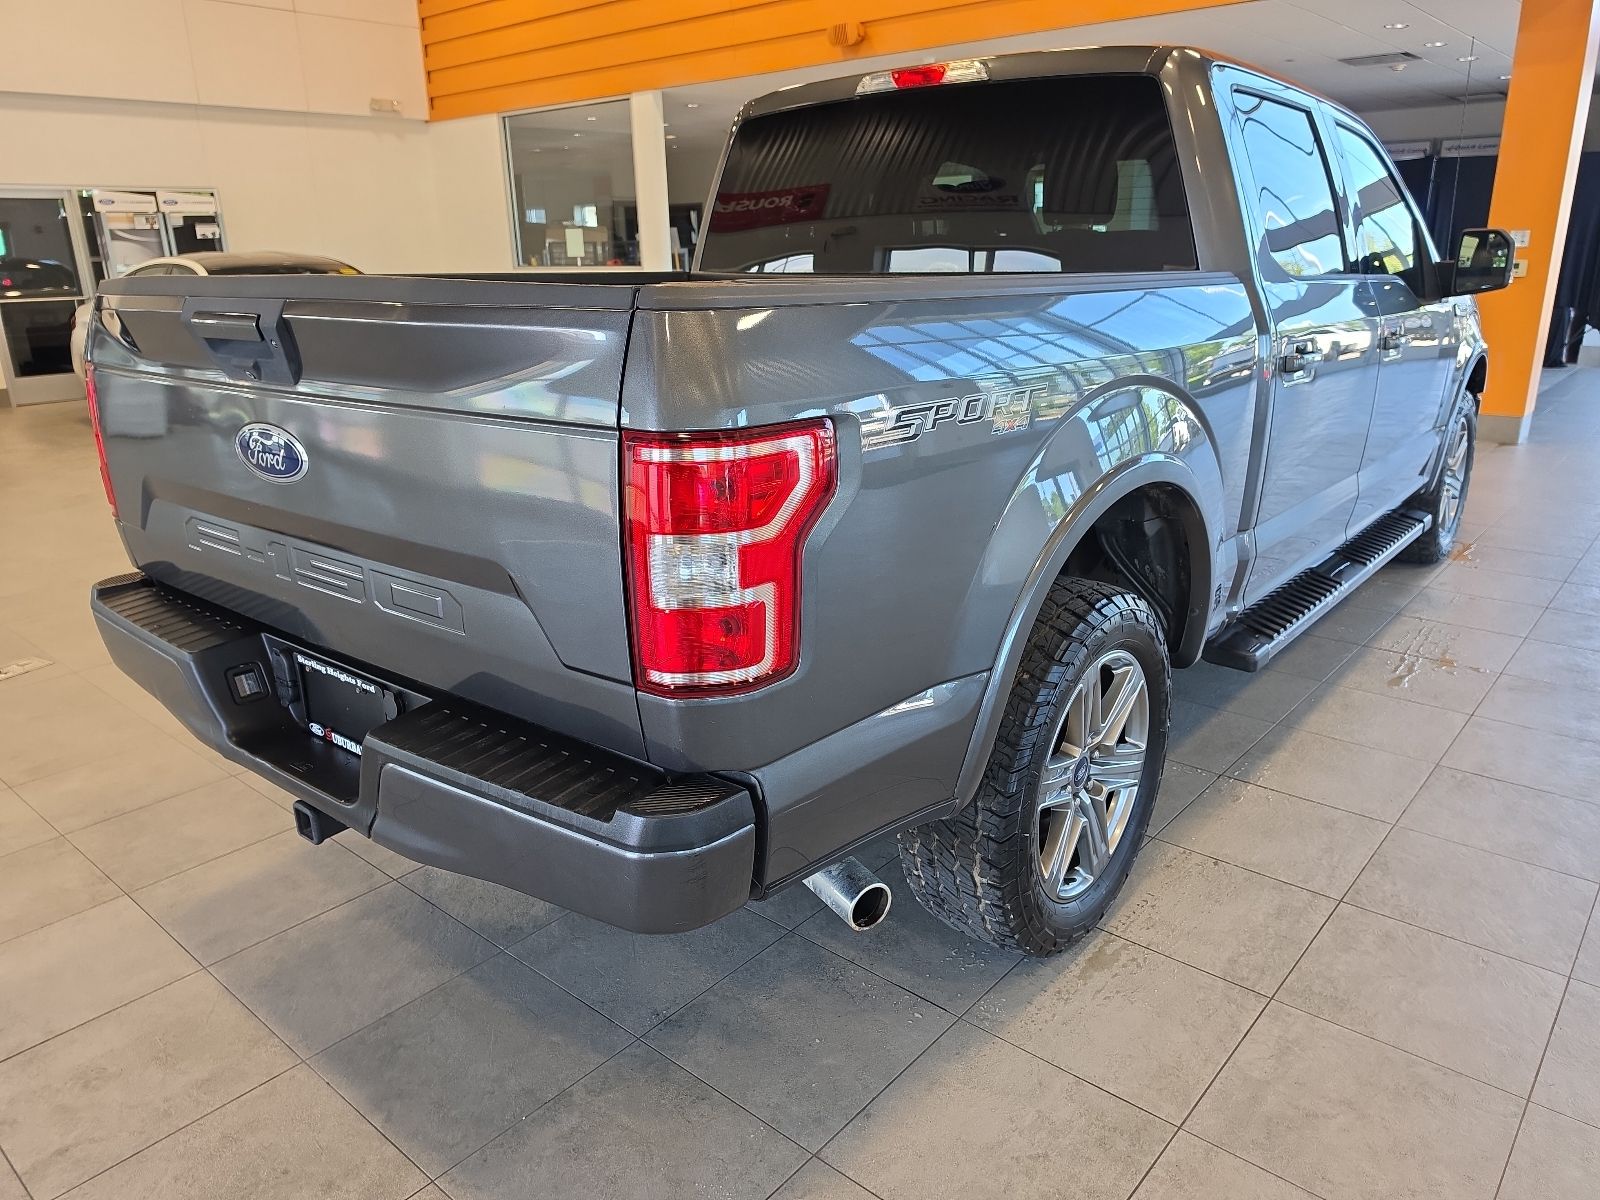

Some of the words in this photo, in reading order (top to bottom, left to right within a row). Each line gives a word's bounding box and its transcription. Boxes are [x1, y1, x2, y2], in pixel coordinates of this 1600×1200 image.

[861, 382, 1048, 453] SPORT
[248, 431, 287, 472] Ford
[185, 516, 466, 636] F-150
[297, 654, 327, 674] Sterling
[326, 666, 356, 685] Heights
[356, 679, 376, 694] Ford
[325, 727, 363, 756] SUBURBA
